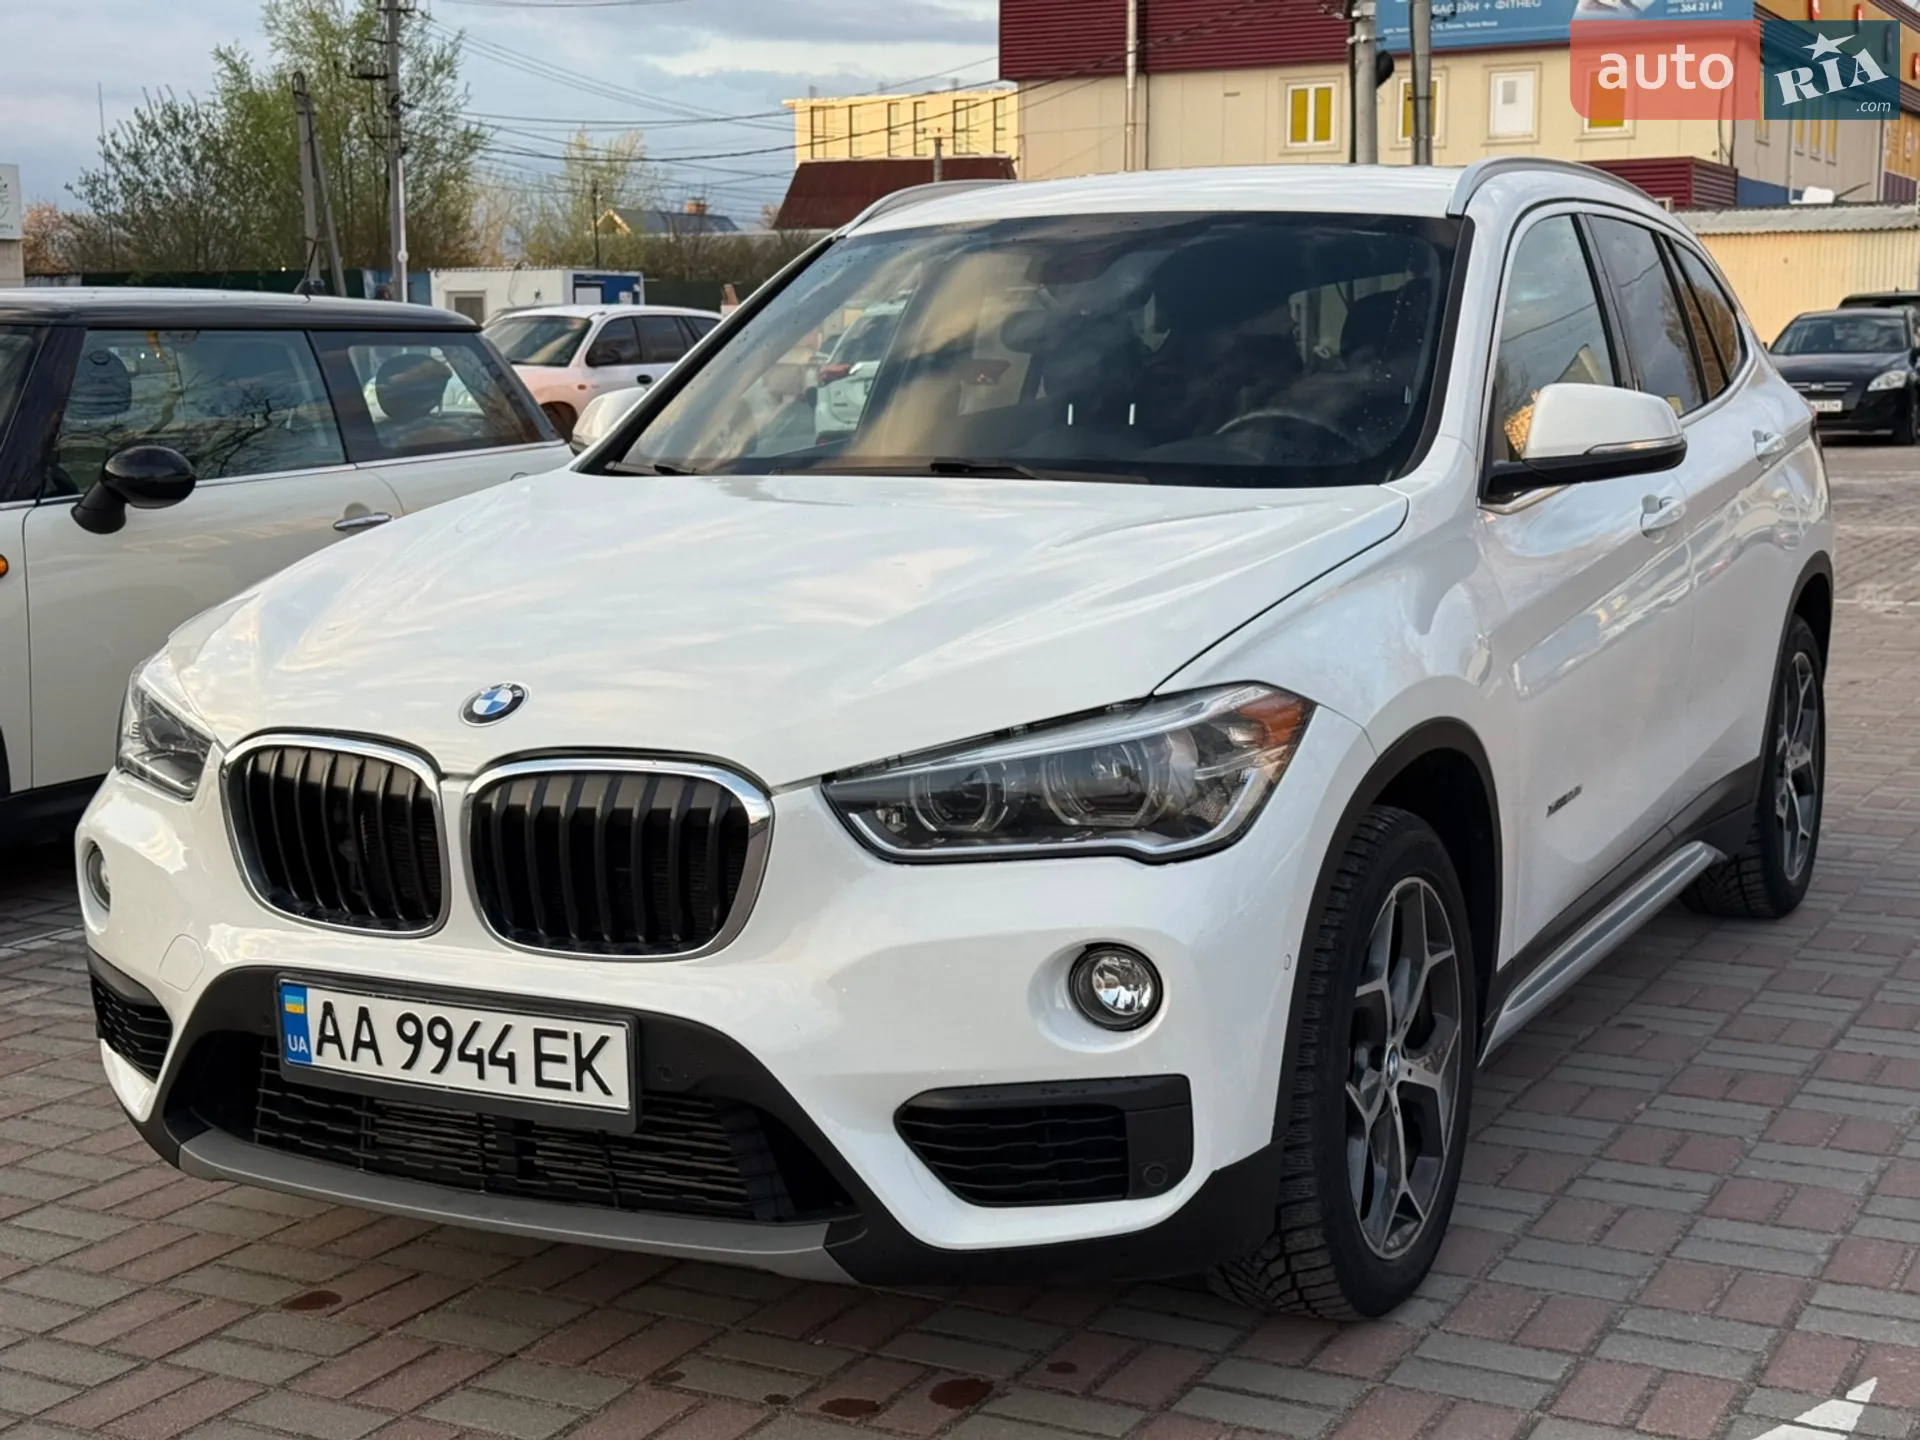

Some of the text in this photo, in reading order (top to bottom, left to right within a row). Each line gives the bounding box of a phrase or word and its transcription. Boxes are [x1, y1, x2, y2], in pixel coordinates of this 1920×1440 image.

[287, 1034, 309, 1055] UA
[315, 1000, 614, 1096] AA 9944 EK
